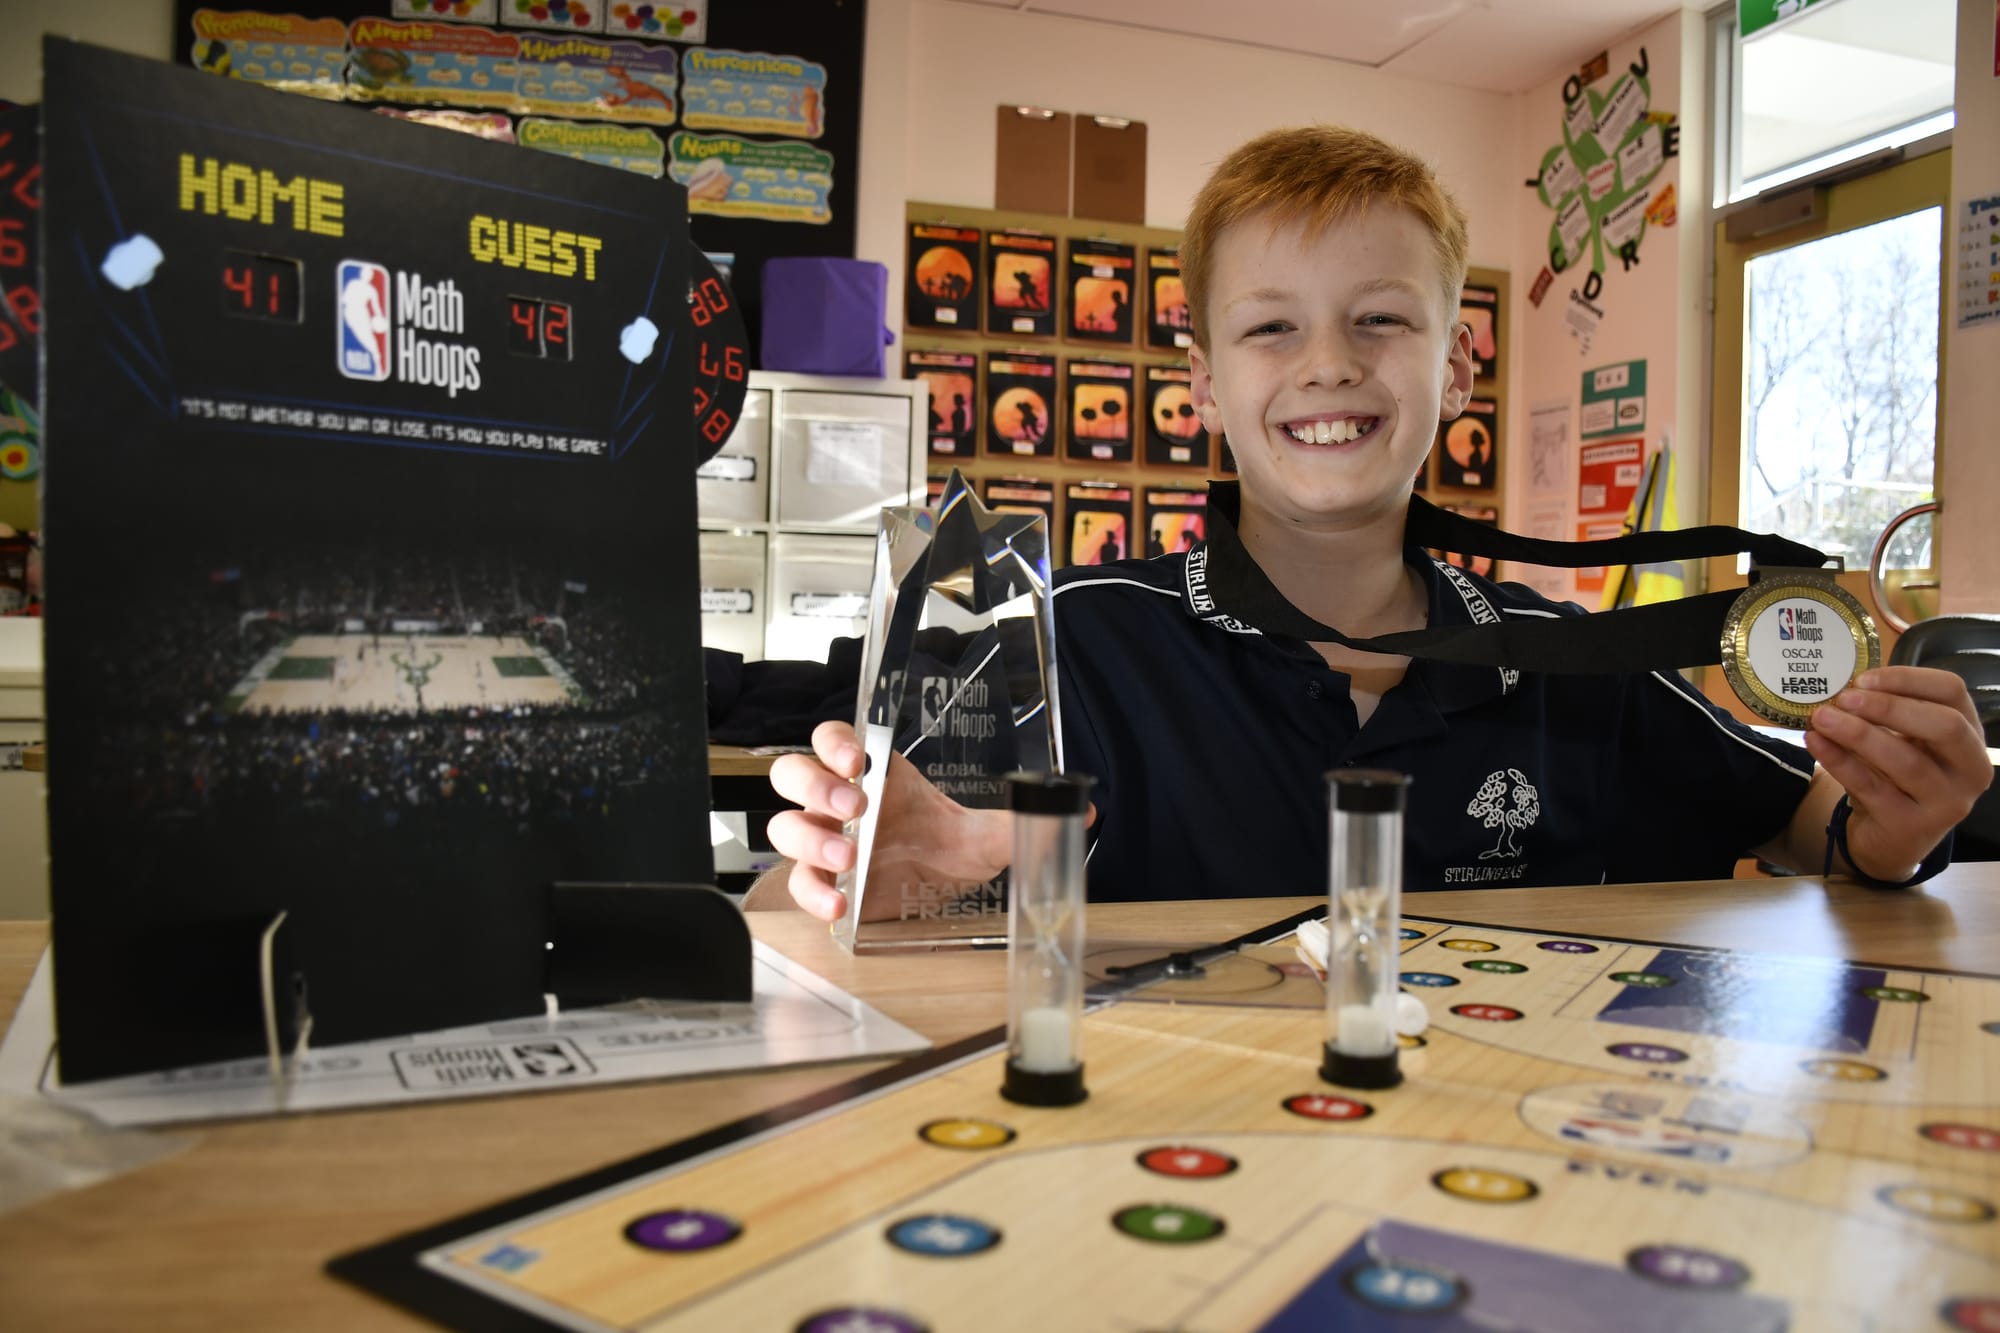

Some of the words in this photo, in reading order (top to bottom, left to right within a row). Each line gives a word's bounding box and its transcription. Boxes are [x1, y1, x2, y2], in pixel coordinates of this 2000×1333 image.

[202, 14, 292, 34] Pronouns
[355, 22, 434, 43] Adverbs
[521, 39, 612, 61] Adjectives
[691, 52, 803, 77] Prepositions
[524, 123, 650, 148] Conjunctions
[680, 137, 742, 158] Nouns
[180, 154, 344, 237] HOME
[470, 214, 602, 280] GUEST
[224, 266, 280, 316] 41
[397, 271, 464, 334] Math
[511, 302, 569, 345] 42
[397, 327, 481, 398] Hoops
[218, 403, 247, 420] NOT
[251, 406, 315, 427] WHETHER
[317, 412, 345, 430] YOU
[347, 416, 370, 432] WIN
[372, 418, 391, 434] OR
[457, 427, 482, 444] HOW
[484, 429, 511, 446] YOU
[511, 431, 544, 450] PLAY
[546, 435, 568, 452] THE
[1795, 608, 1817, 625] Math
[1796, 624, 1823, 644] Hoops
[1781, 648, 1823, 659] OSCAR
[951, 677, 989, 708] Math
[1781, 677, 1828, 686] LEARN
[1781, 685, 1828, 695] FRESH
[951, 706, 997, 742] Hoops
[926, 763, 987, 777] GLOBAL
[901, 880, 1004, 900] LEARN
[901, 901, 1002, 921] FRESH
[408, 1047, 504, 1069] Hoops
[434, 1064, 515, 1086] Math
